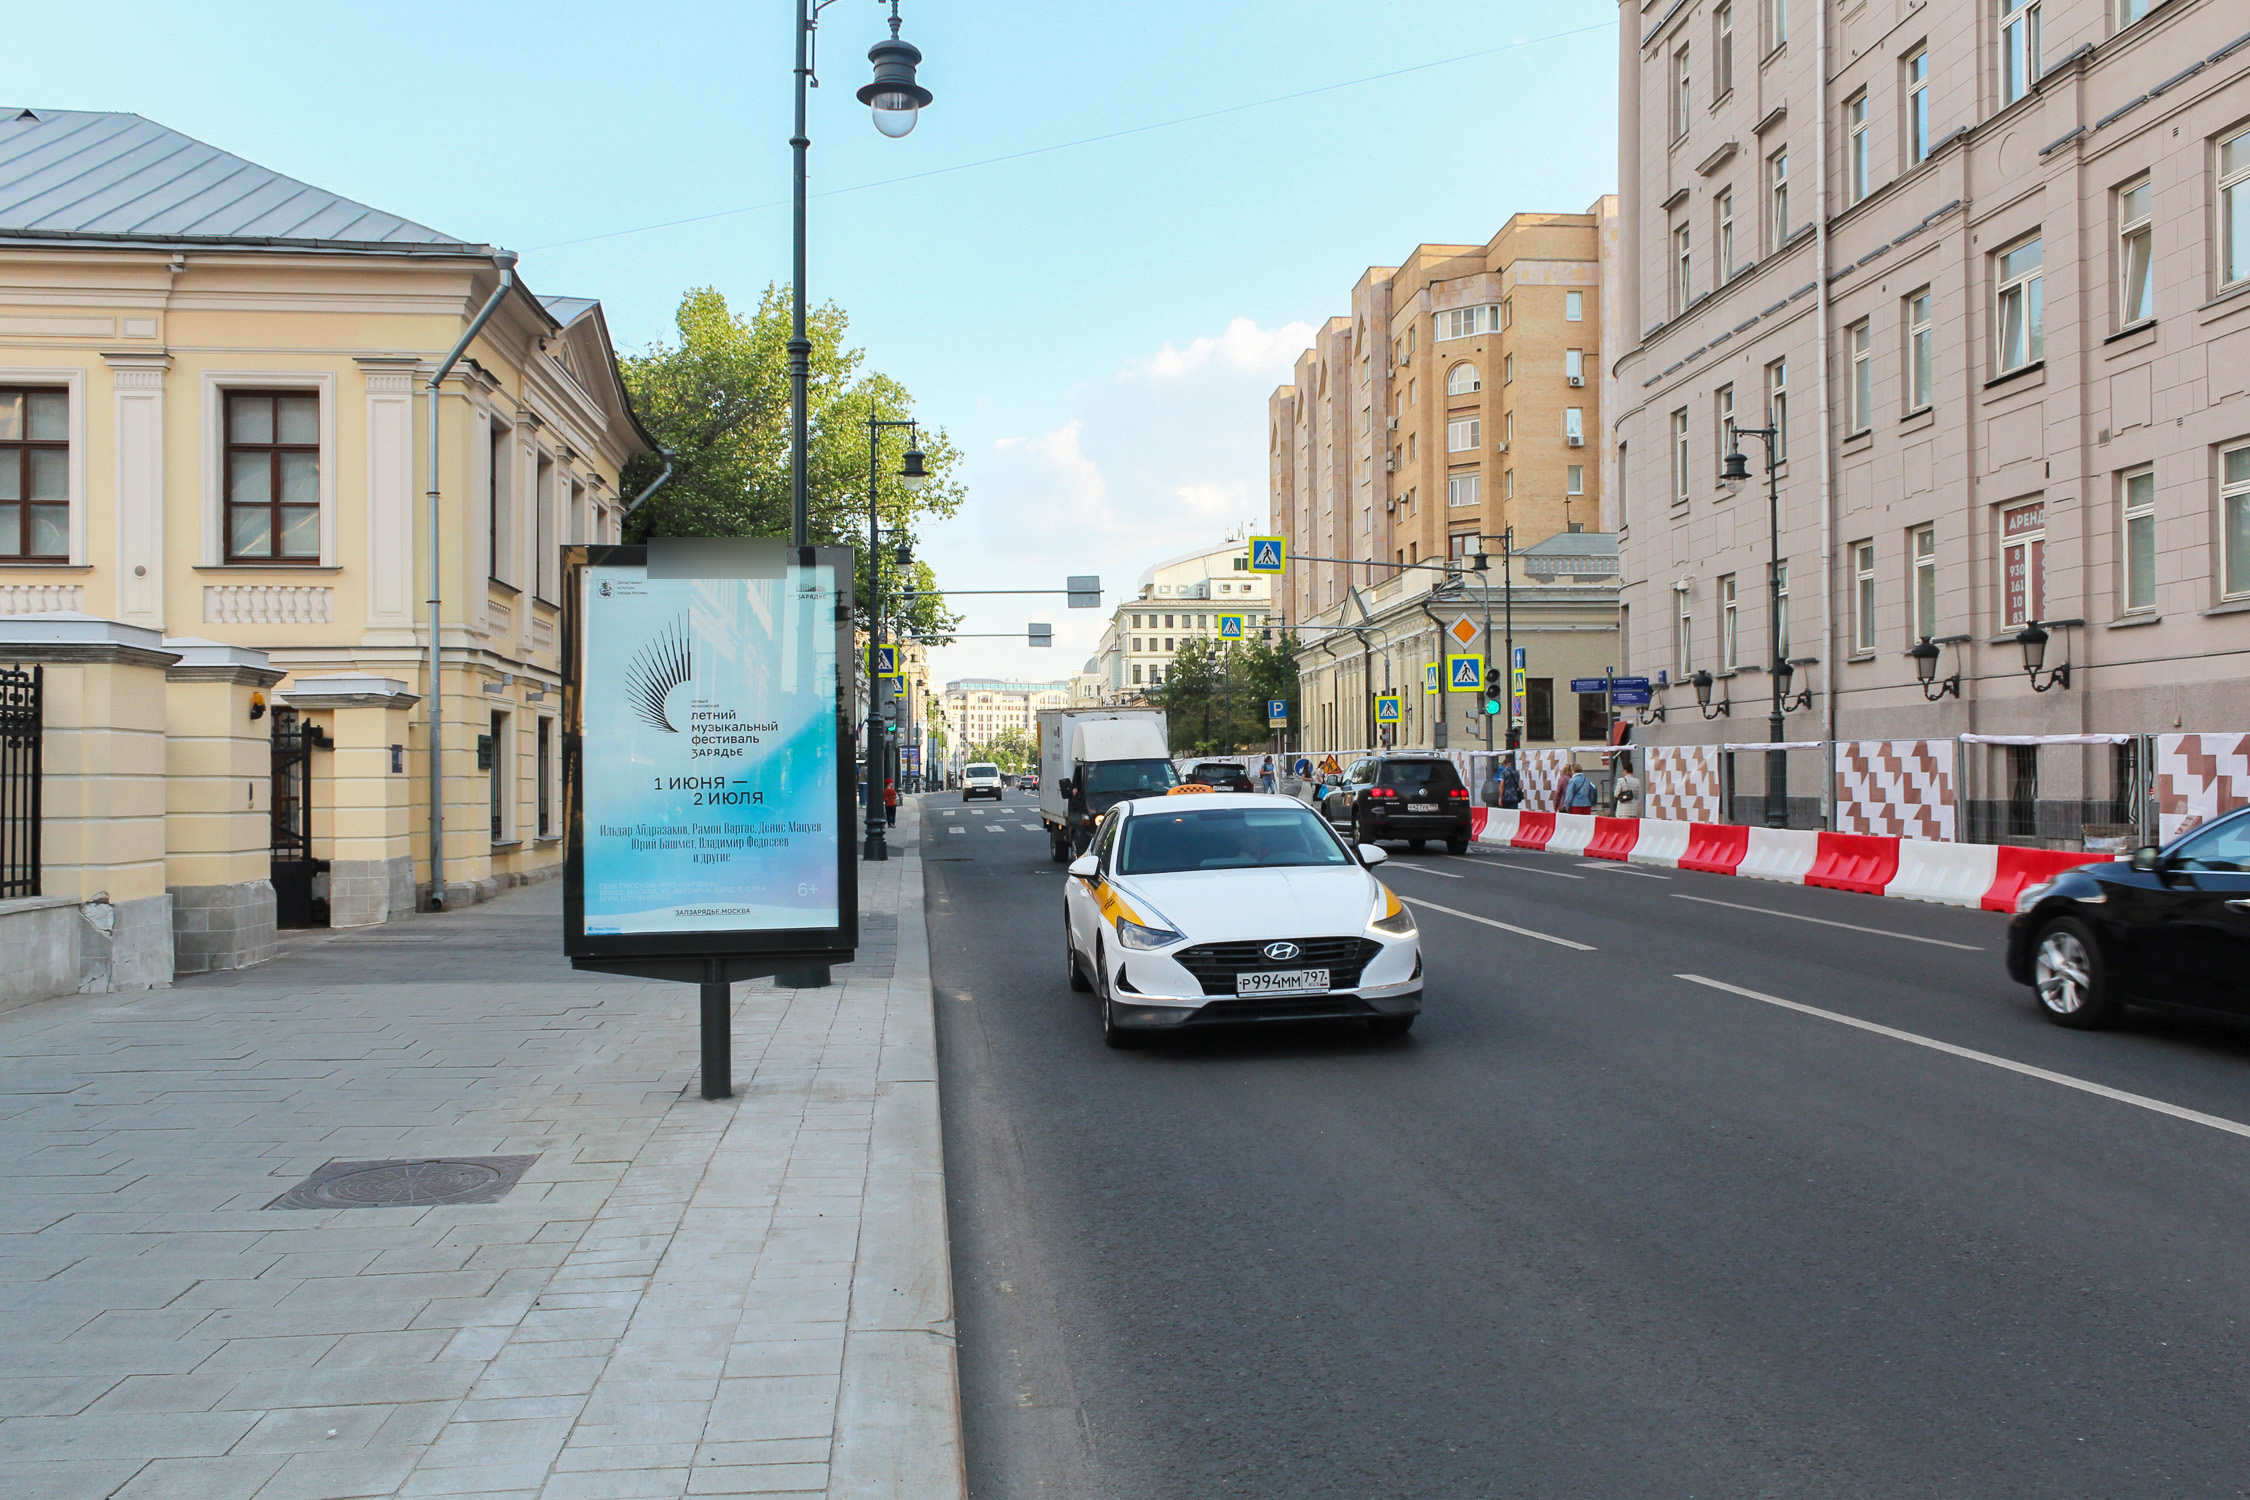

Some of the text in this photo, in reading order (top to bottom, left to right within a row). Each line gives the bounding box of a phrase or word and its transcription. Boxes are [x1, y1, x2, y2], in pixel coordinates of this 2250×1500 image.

[2014, 549, 2020, 560] 8
[2009, 565, 2025, 577] 930
[2011, 580, 2025, 592] 161
[2013, 596, 2023, 608] 10
[2012, 612, 2023, 624] 83
[691, 709, 736, 720] летний
[691, 721, 779, 734] музыкальный
[691, 735, 760, 746] фестиваль
[691, 748, 744, 760] ЗАРЯДЬЕ
[654, 777, 662, 790] 1
[669, 776, 725, 790] ИЮНЯ
[693, 791, 763, 806] 2 ИЮЛЯ
[600, 820, 822, 838] Ильдар Абдразаков, Рамон Варгас, Денис Мацуев
[631, 835, 789, 852] Юрий Башмет, Владимир Федосеев
[693, 853, 731, 865] и другие
[798, 882, 818, 897] 6+
[675, 908, 751, 916] ЗАЛЗАРЯДЬЕ.МОСКВА
[1242, 971, 1325, 990] Р994ММ 797
